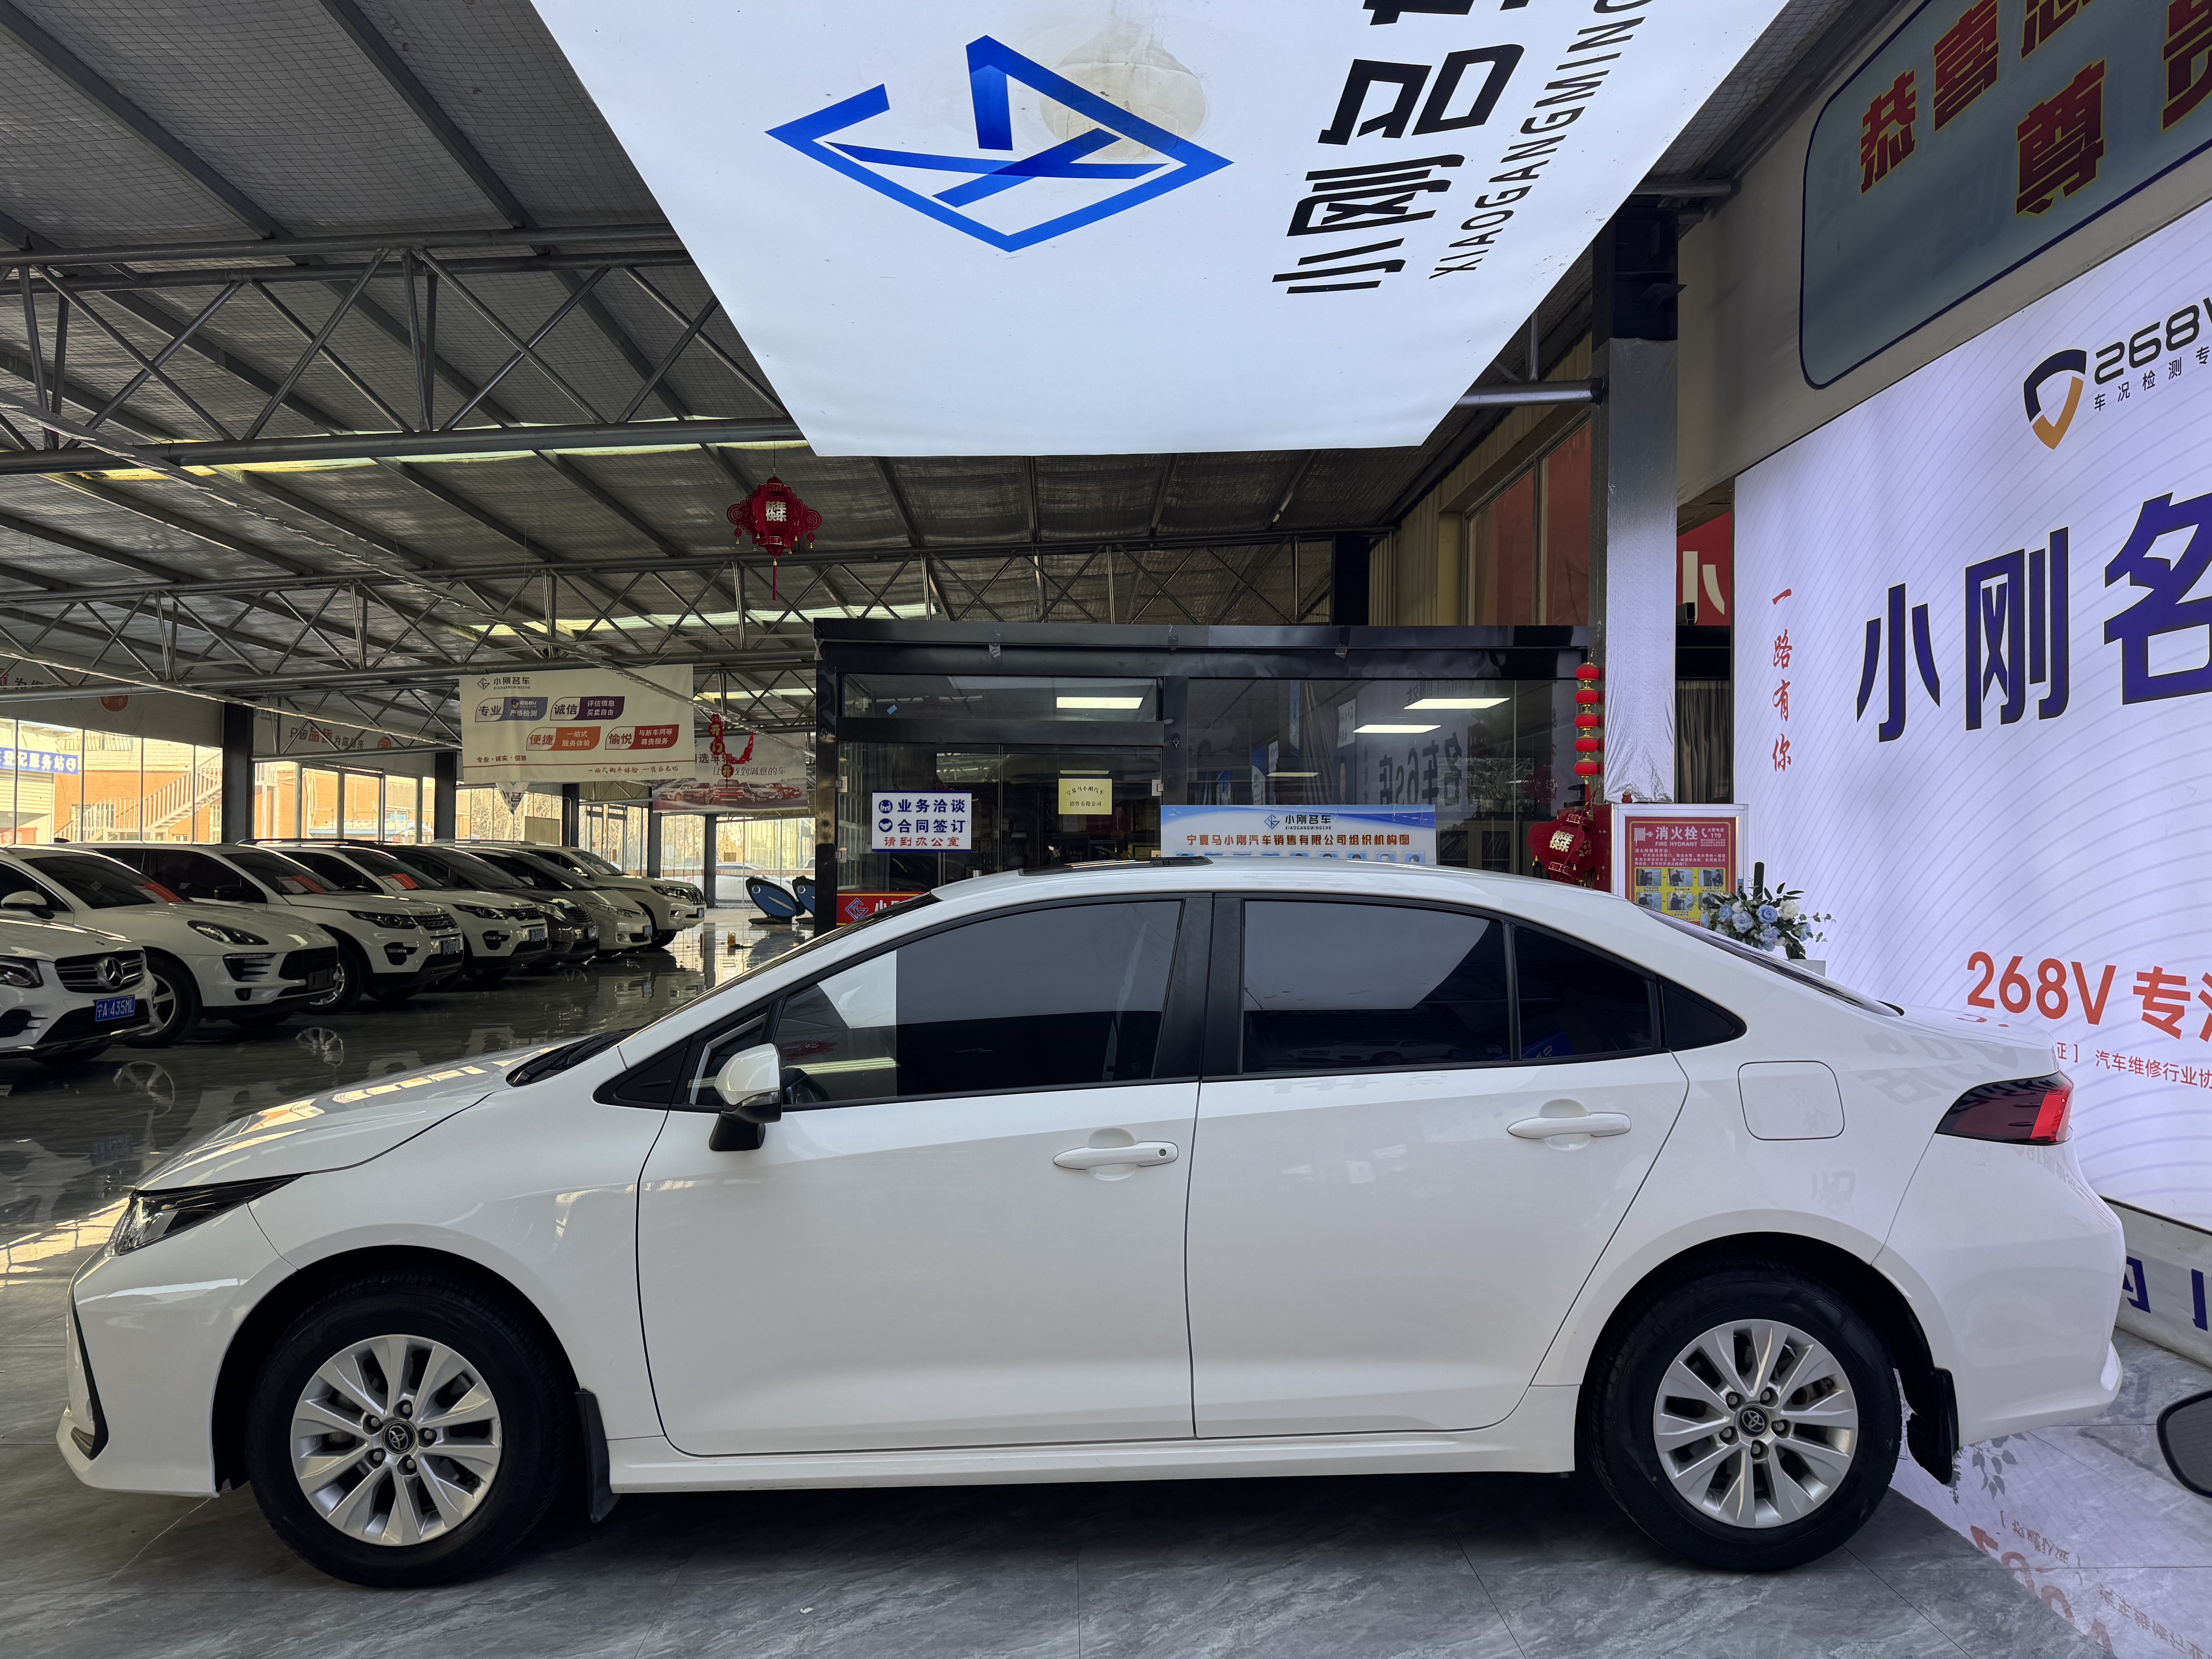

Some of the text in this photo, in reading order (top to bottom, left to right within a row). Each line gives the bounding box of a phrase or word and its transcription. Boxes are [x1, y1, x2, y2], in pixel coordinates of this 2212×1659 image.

[494, 676, 530, 685] 小刚名车
[1772, 588, 1793, 773] 一路有你
[478, 705, 502, 716] 专业
[554, 703, 578, 715] 诚信
[638, 728, 673, 736] 与新车同等
[529, 733, 555, 745] 便捷
[608, 733, 632, 745] 愉悦
[0, 750, 65, 771] 登记服务站
[898, 799, 966, 813] 业务洽谈
[1285, 814, 1331, 824] 小刚名车
[897, 819, 965, 833] 合同签订
[1655, 826, 1698, 840] 消火栓
[884, 836, 960, 847] 请到办公室
[1187, 834, 1410, 846] 宁夏马小刚汽车销售有限公司组织机构图
[1966, 951, 2117, 1026] 268V
